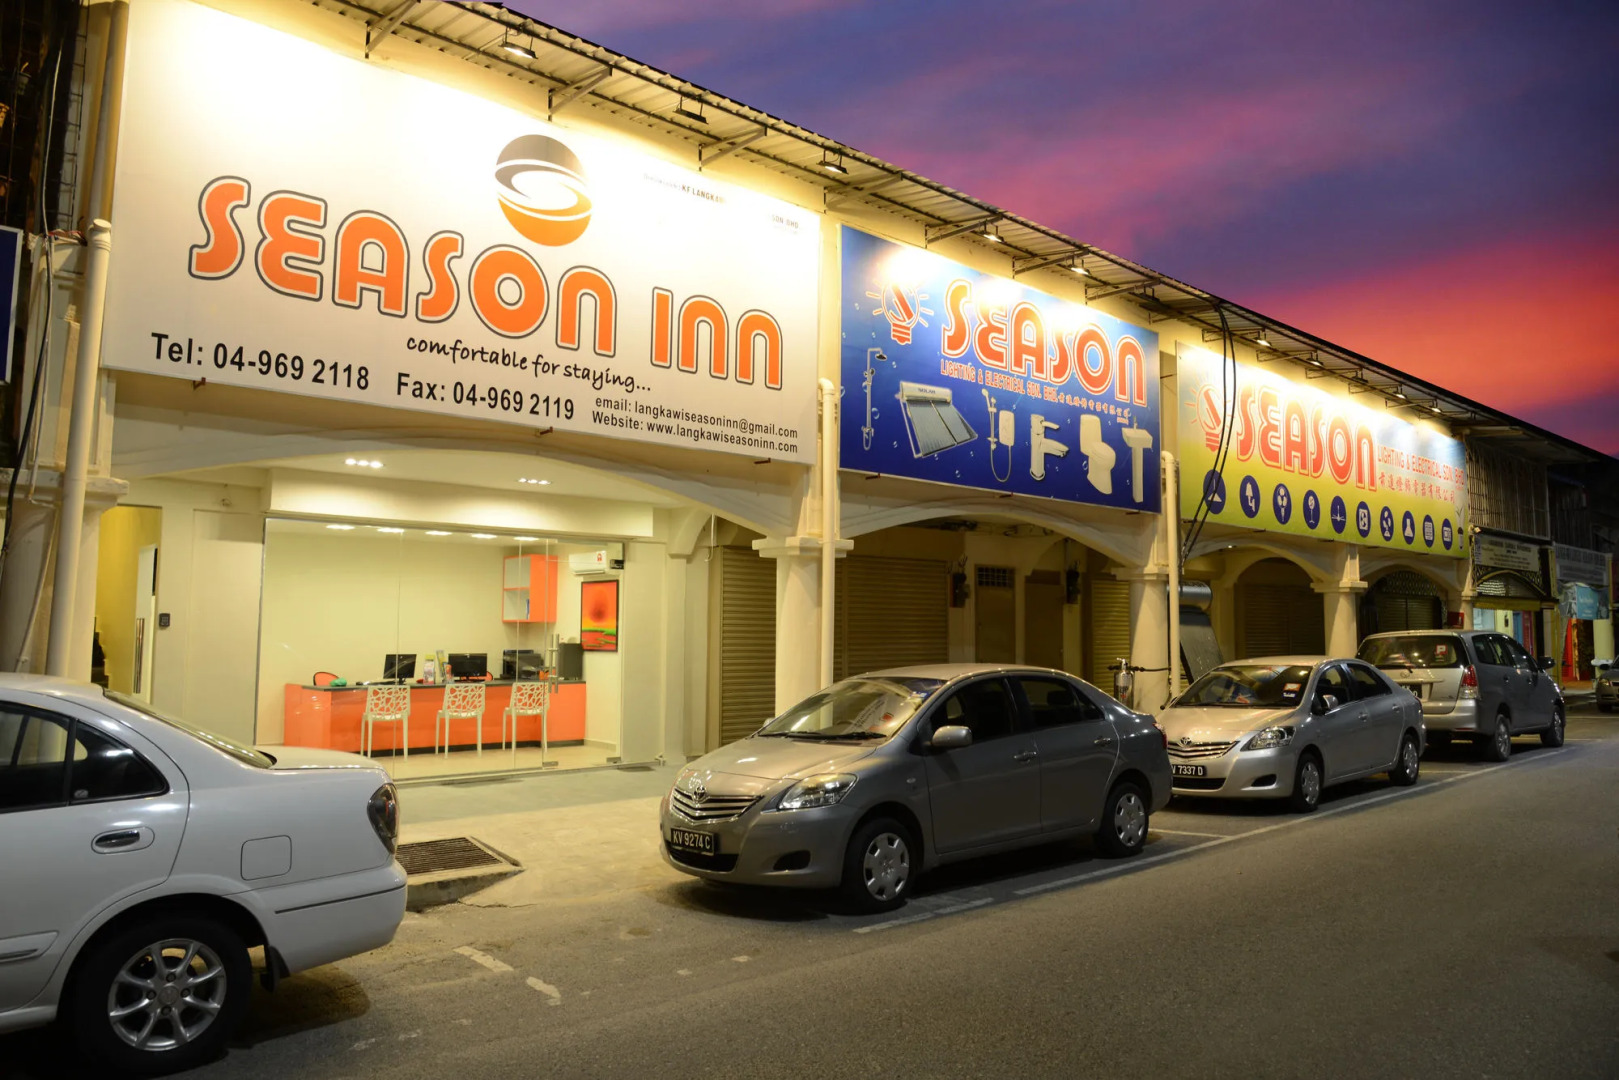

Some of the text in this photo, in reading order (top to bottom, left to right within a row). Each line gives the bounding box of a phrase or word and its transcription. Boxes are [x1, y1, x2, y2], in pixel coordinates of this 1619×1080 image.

[188, 175, 617, 358] SEASON
[151, 332, 369, 391] Tel: 04-969 2118
[406, 337, 651, 392] comfortable for staying...
[941, 279, 1147, 407] SEASON
[397, 373, 574, 420] Fax: 04-969 2119
[940, 359, 976, 382] LIGHTING
[977, 368, 984, 385] &
[985, 370, 1026, 395] ELECTRICAL
[592, 411, 798, 453] Website: www.langkawiseasoninn.com
[595, 397, 798, 438] email: langkawiseasoninn@gmail.com
[1236, 384, 1377, 492] SEASON
[1378, 445, 1405, 469] LIGHTING
[1412, 453, 1442, 479] ELECTRICAL
[1178, 766, 1195, 775] 7337
[673, 831, 710, 849] KV 9274 C
